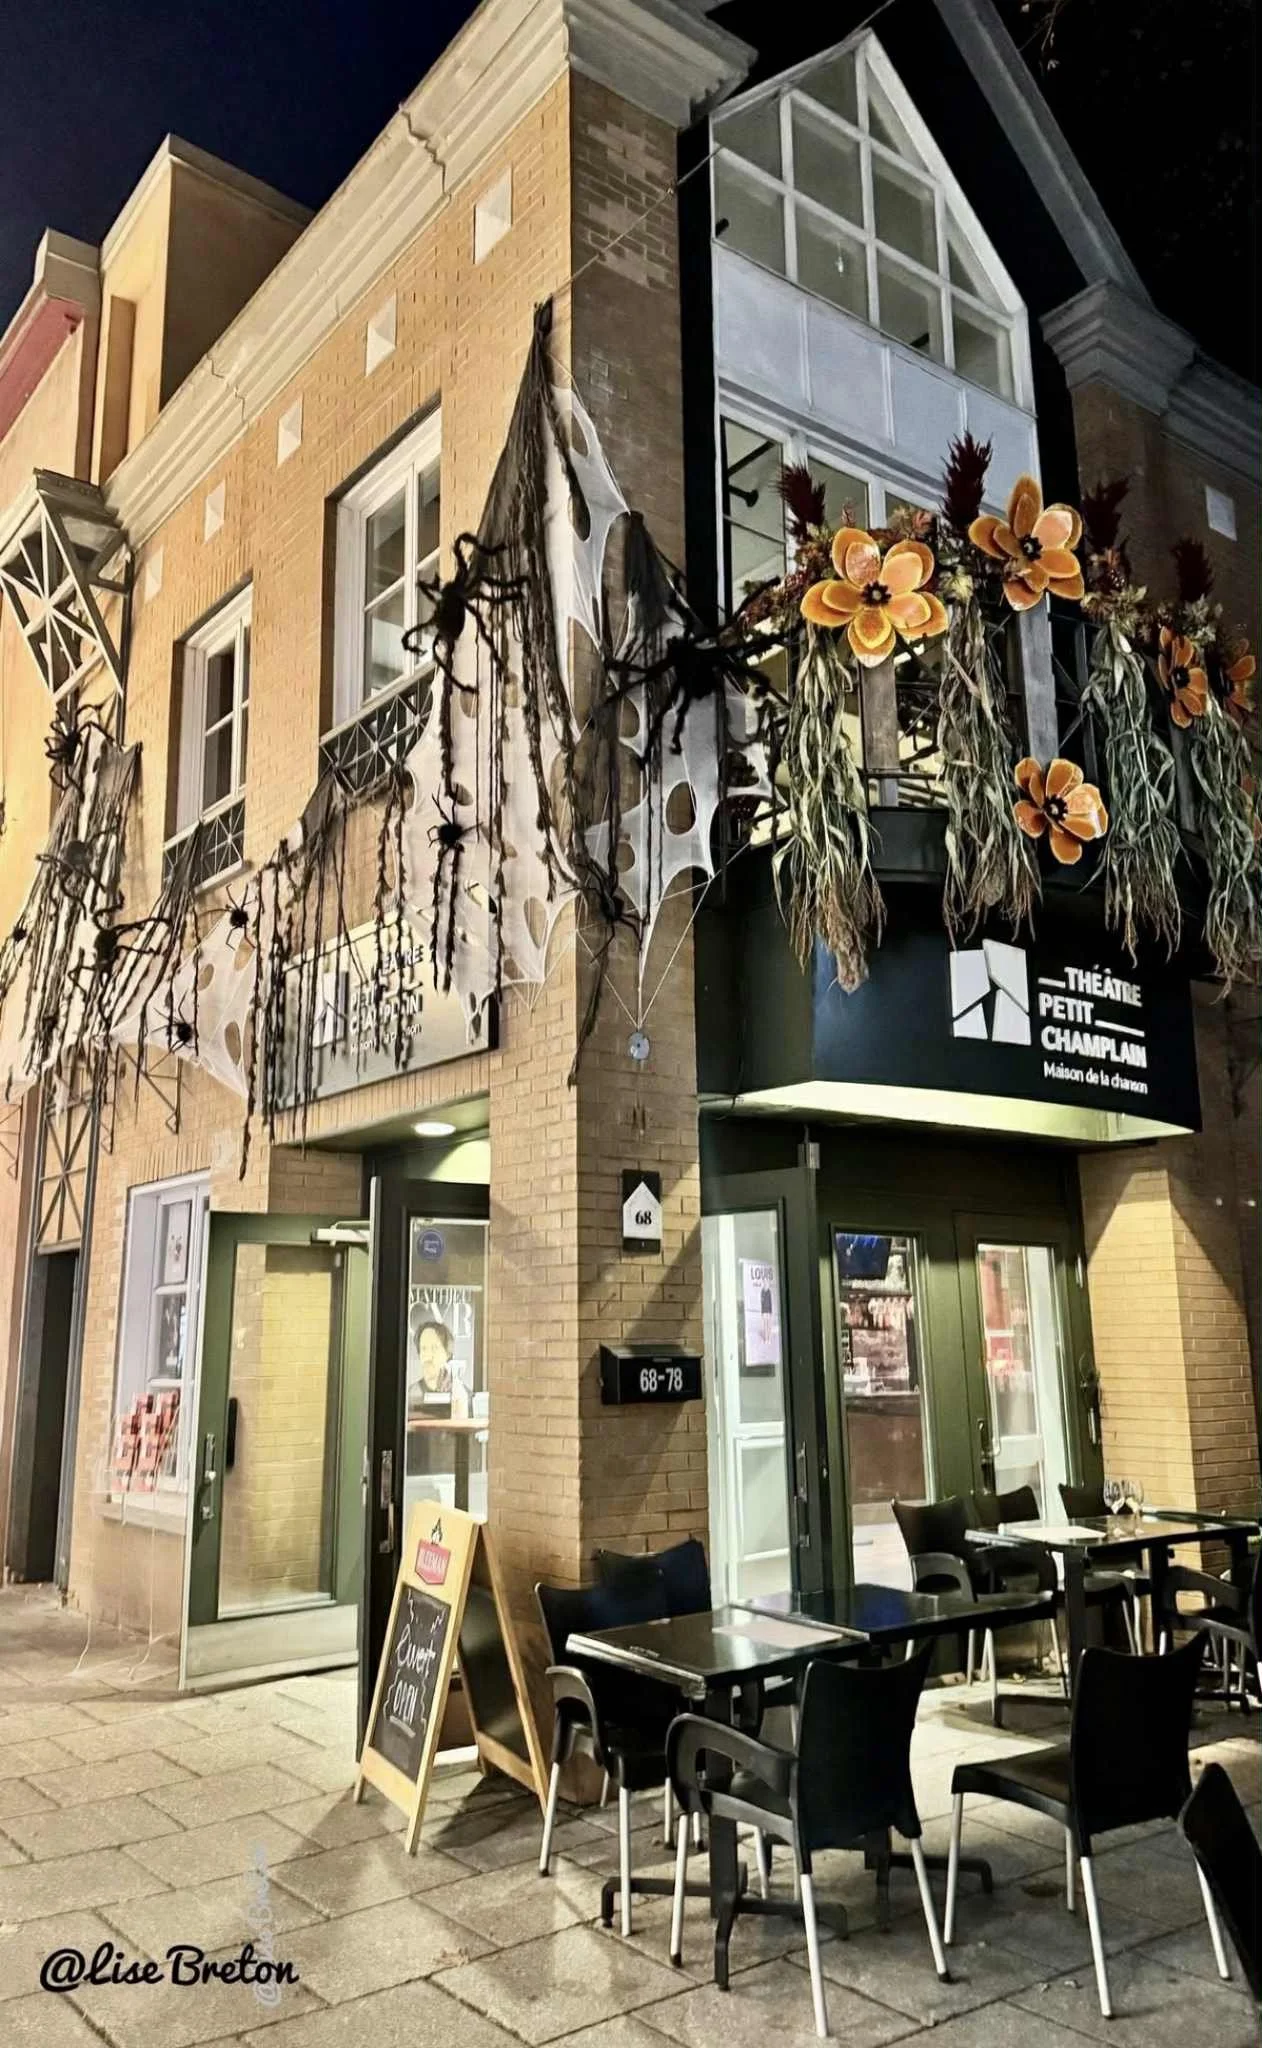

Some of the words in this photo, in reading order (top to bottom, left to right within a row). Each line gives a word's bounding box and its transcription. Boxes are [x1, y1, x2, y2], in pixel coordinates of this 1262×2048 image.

[1064, 964, 1142, 1007] THÉÂTRE
[1038, 992, 1094, 1025] PETIT
[1041, 1025, 1147, 1068] CHAMPLAIN
[1043, 1060, 1084, 1083] Maison
[1085, 1067, 1099, 1085] de
[1100, 1068, 1110, 1087] la
[1111, 1072, 1148, 1095] chanson
[635, 1210, 652, 1225] 68
[640, 1367, 683, 1392] 68-78
